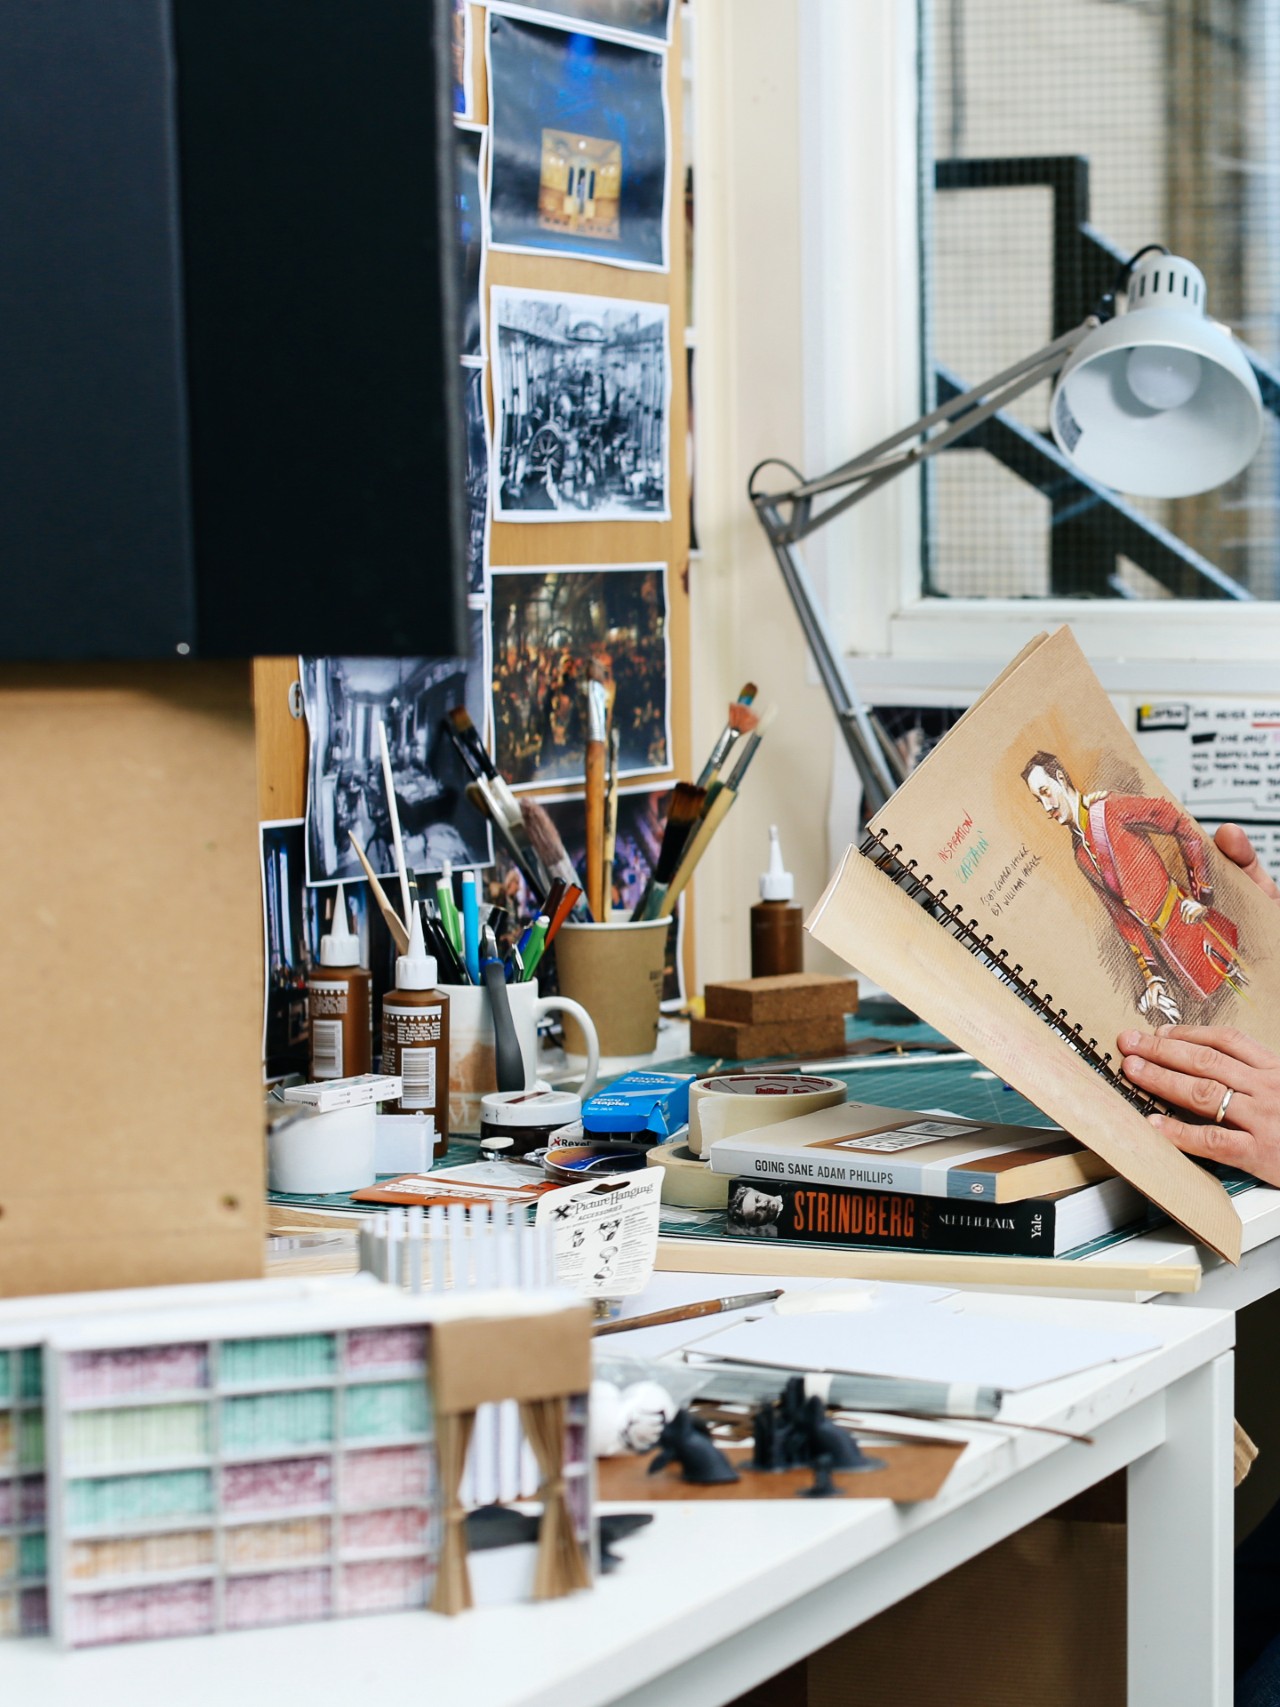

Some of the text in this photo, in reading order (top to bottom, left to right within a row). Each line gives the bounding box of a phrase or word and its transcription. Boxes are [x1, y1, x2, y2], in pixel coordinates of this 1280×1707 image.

[937, 807, 974, 864] INSPIRATION
[755, 1159, 894, 1185] GOING SANE ADAM PHILLIPS
[575, 1183, 654, 1215] Picture Hanging
[793, 1190, 915, 1238] STRINDBERG
[1031, 1213, 1043, 1239] Yale
